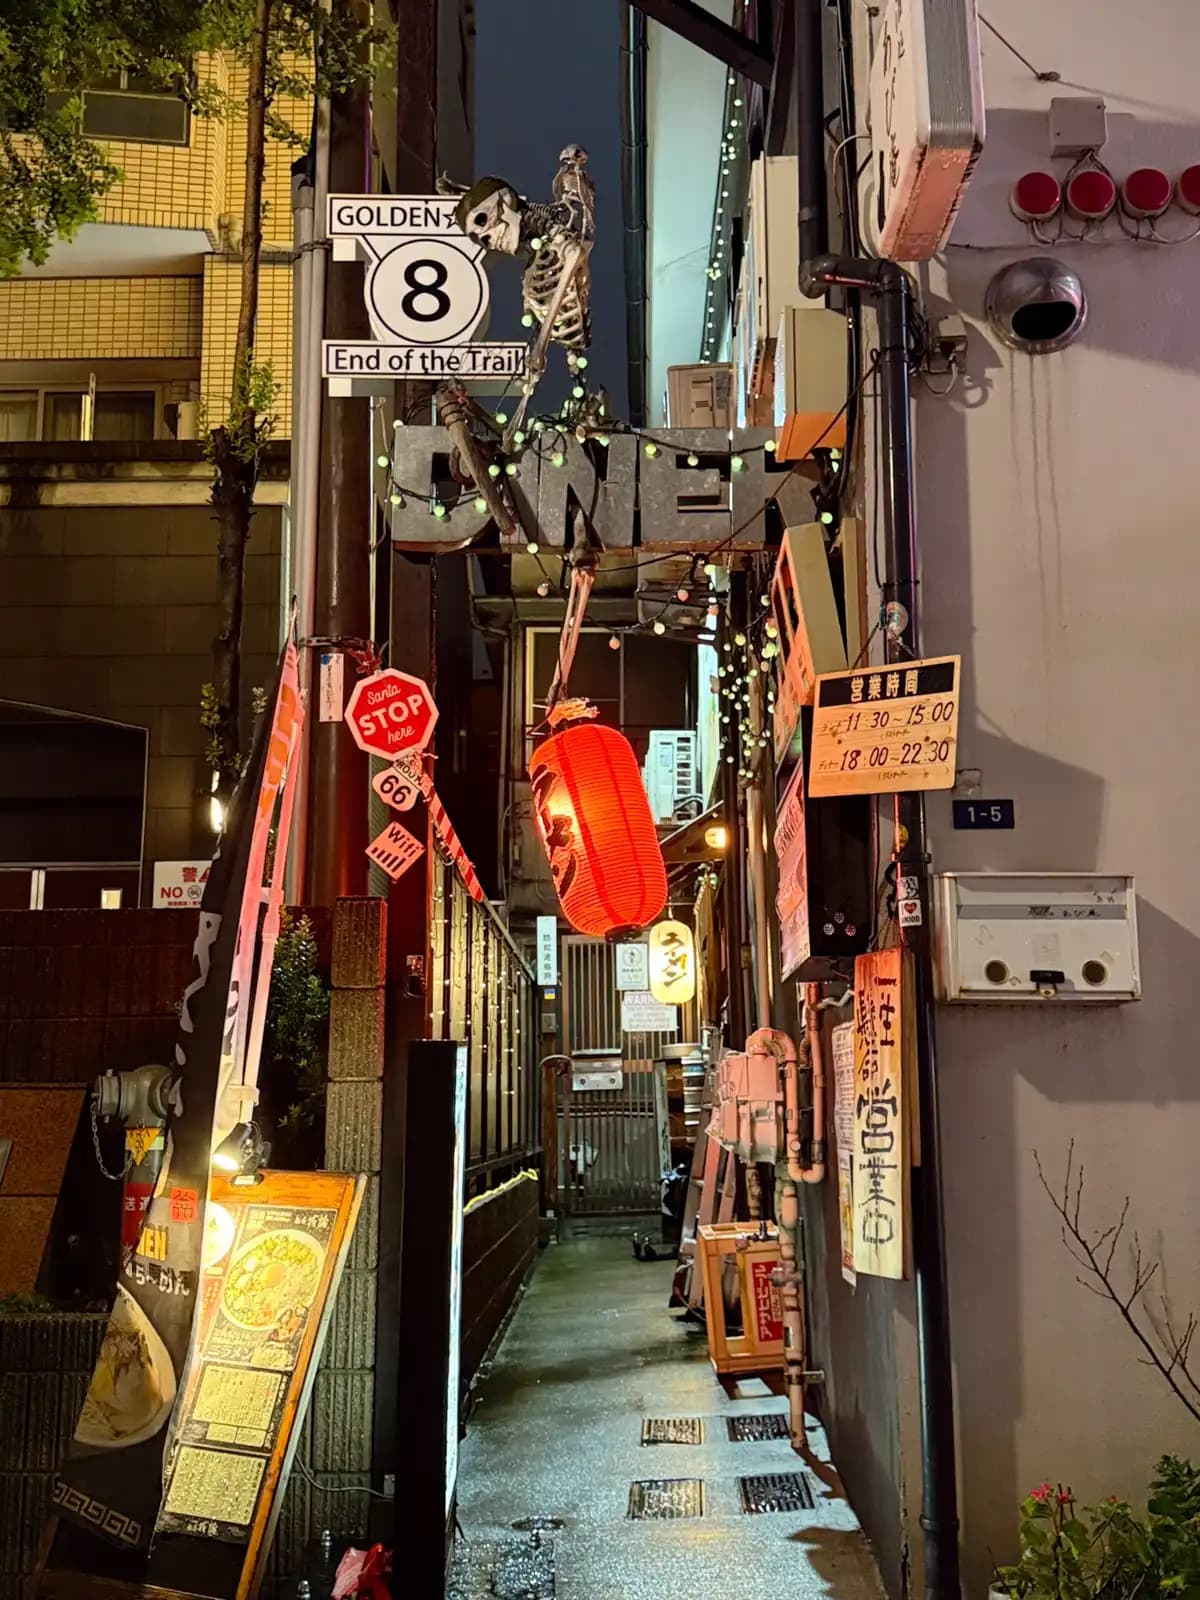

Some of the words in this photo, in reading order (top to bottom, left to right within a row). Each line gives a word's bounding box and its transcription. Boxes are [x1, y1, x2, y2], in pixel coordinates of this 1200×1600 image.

[337, 206, 440, 227] GOLDEN
[401, 259, 450, 322] 8
[335, 349, 380, 370] End
[388, 349, 414, 370] of
[419, 349, 460, 371] the
[468, 349, 521, 372] Trail
[367, 683, 402, 706] Santa
[851, 669, 919, 703] 営業時間
[358, 693, 424, 737] STOP
[387, 724, 416, 745] here
[395, 760, 423, 788] ROUT
[380, 775, 411, 804] 66
[388, 825, 420, 858] Wifi
[160, 886, 183, 899] NO
[856, 1078, 898, 1257] 営業中
[754, 1264, 774, 1340] アサヒビール
